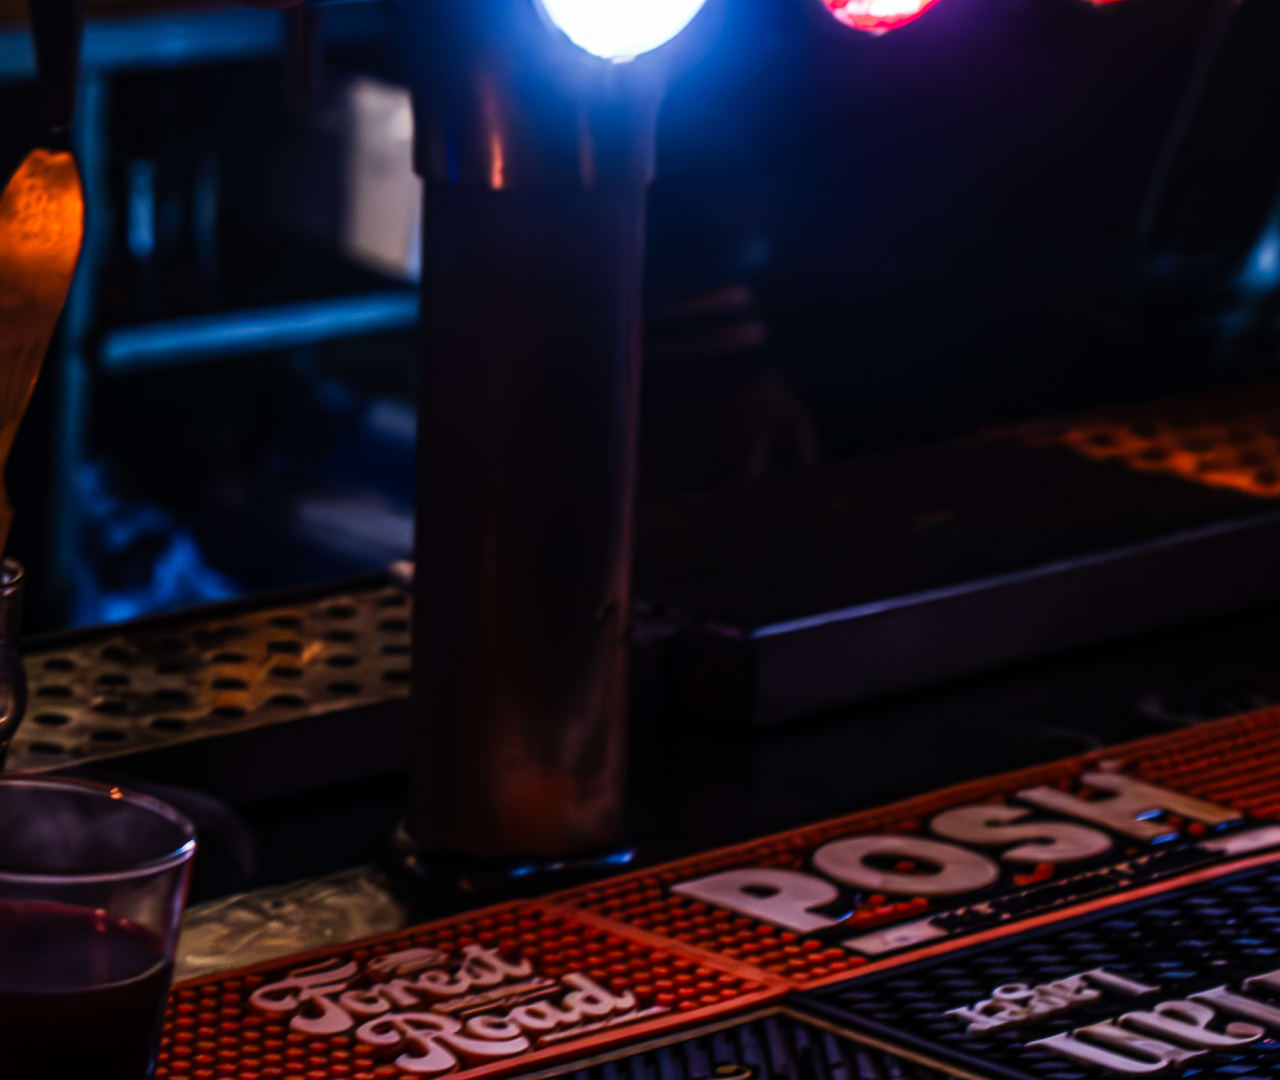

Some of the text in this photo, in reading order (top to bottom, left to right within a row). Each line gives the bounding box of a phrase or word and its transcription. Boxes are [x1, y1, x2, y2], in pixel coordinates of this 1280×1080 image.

[669, 758, 1243, 935] POSH
[248, 942, 534, 1035] Forest
[354, 972, 638, 1072] Road
